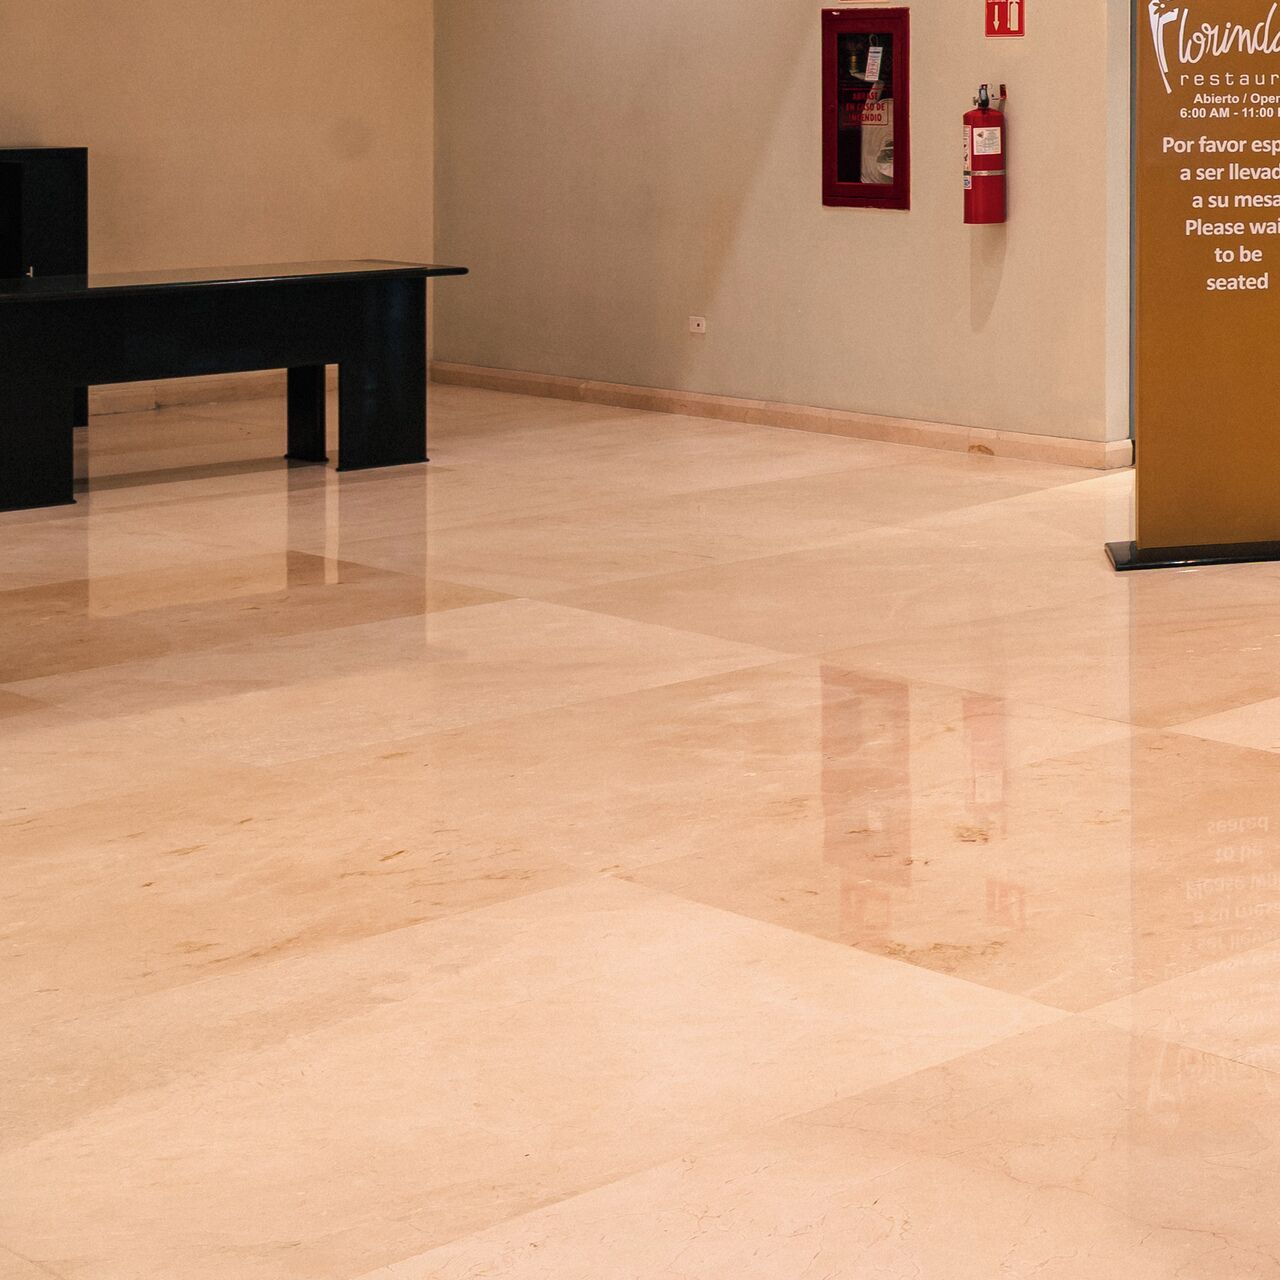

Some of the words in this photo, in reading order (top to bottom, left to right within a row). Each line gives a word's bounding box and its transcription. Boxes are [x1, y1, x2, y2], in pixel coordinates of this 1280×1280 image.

[1193, 93, 1240, 104] Abierto
[1243, 93, 1247, 104] /
[876, 103, 885, 111] DE
[1179, 107, 1207, 118] 6:00
[1209, 107, 1231, 118] AM
[1242, 107, 1275, 118] 11:00
[1162, 137, 1195, 153] Por
[1198, 136, 1247, 153] favor
[1180, 168, 1191, 180] a
[1195, 168, 1224, 180] ser
[1192, 196, 1203, 208] a
[1208, 195, 1229, 208] su
[1185, 219, 1245, 236] Please
[1214, 248, 1234, 263] to
[1240, 246, 1263, 263] be
[1206, 273, 1269, 291] seated
